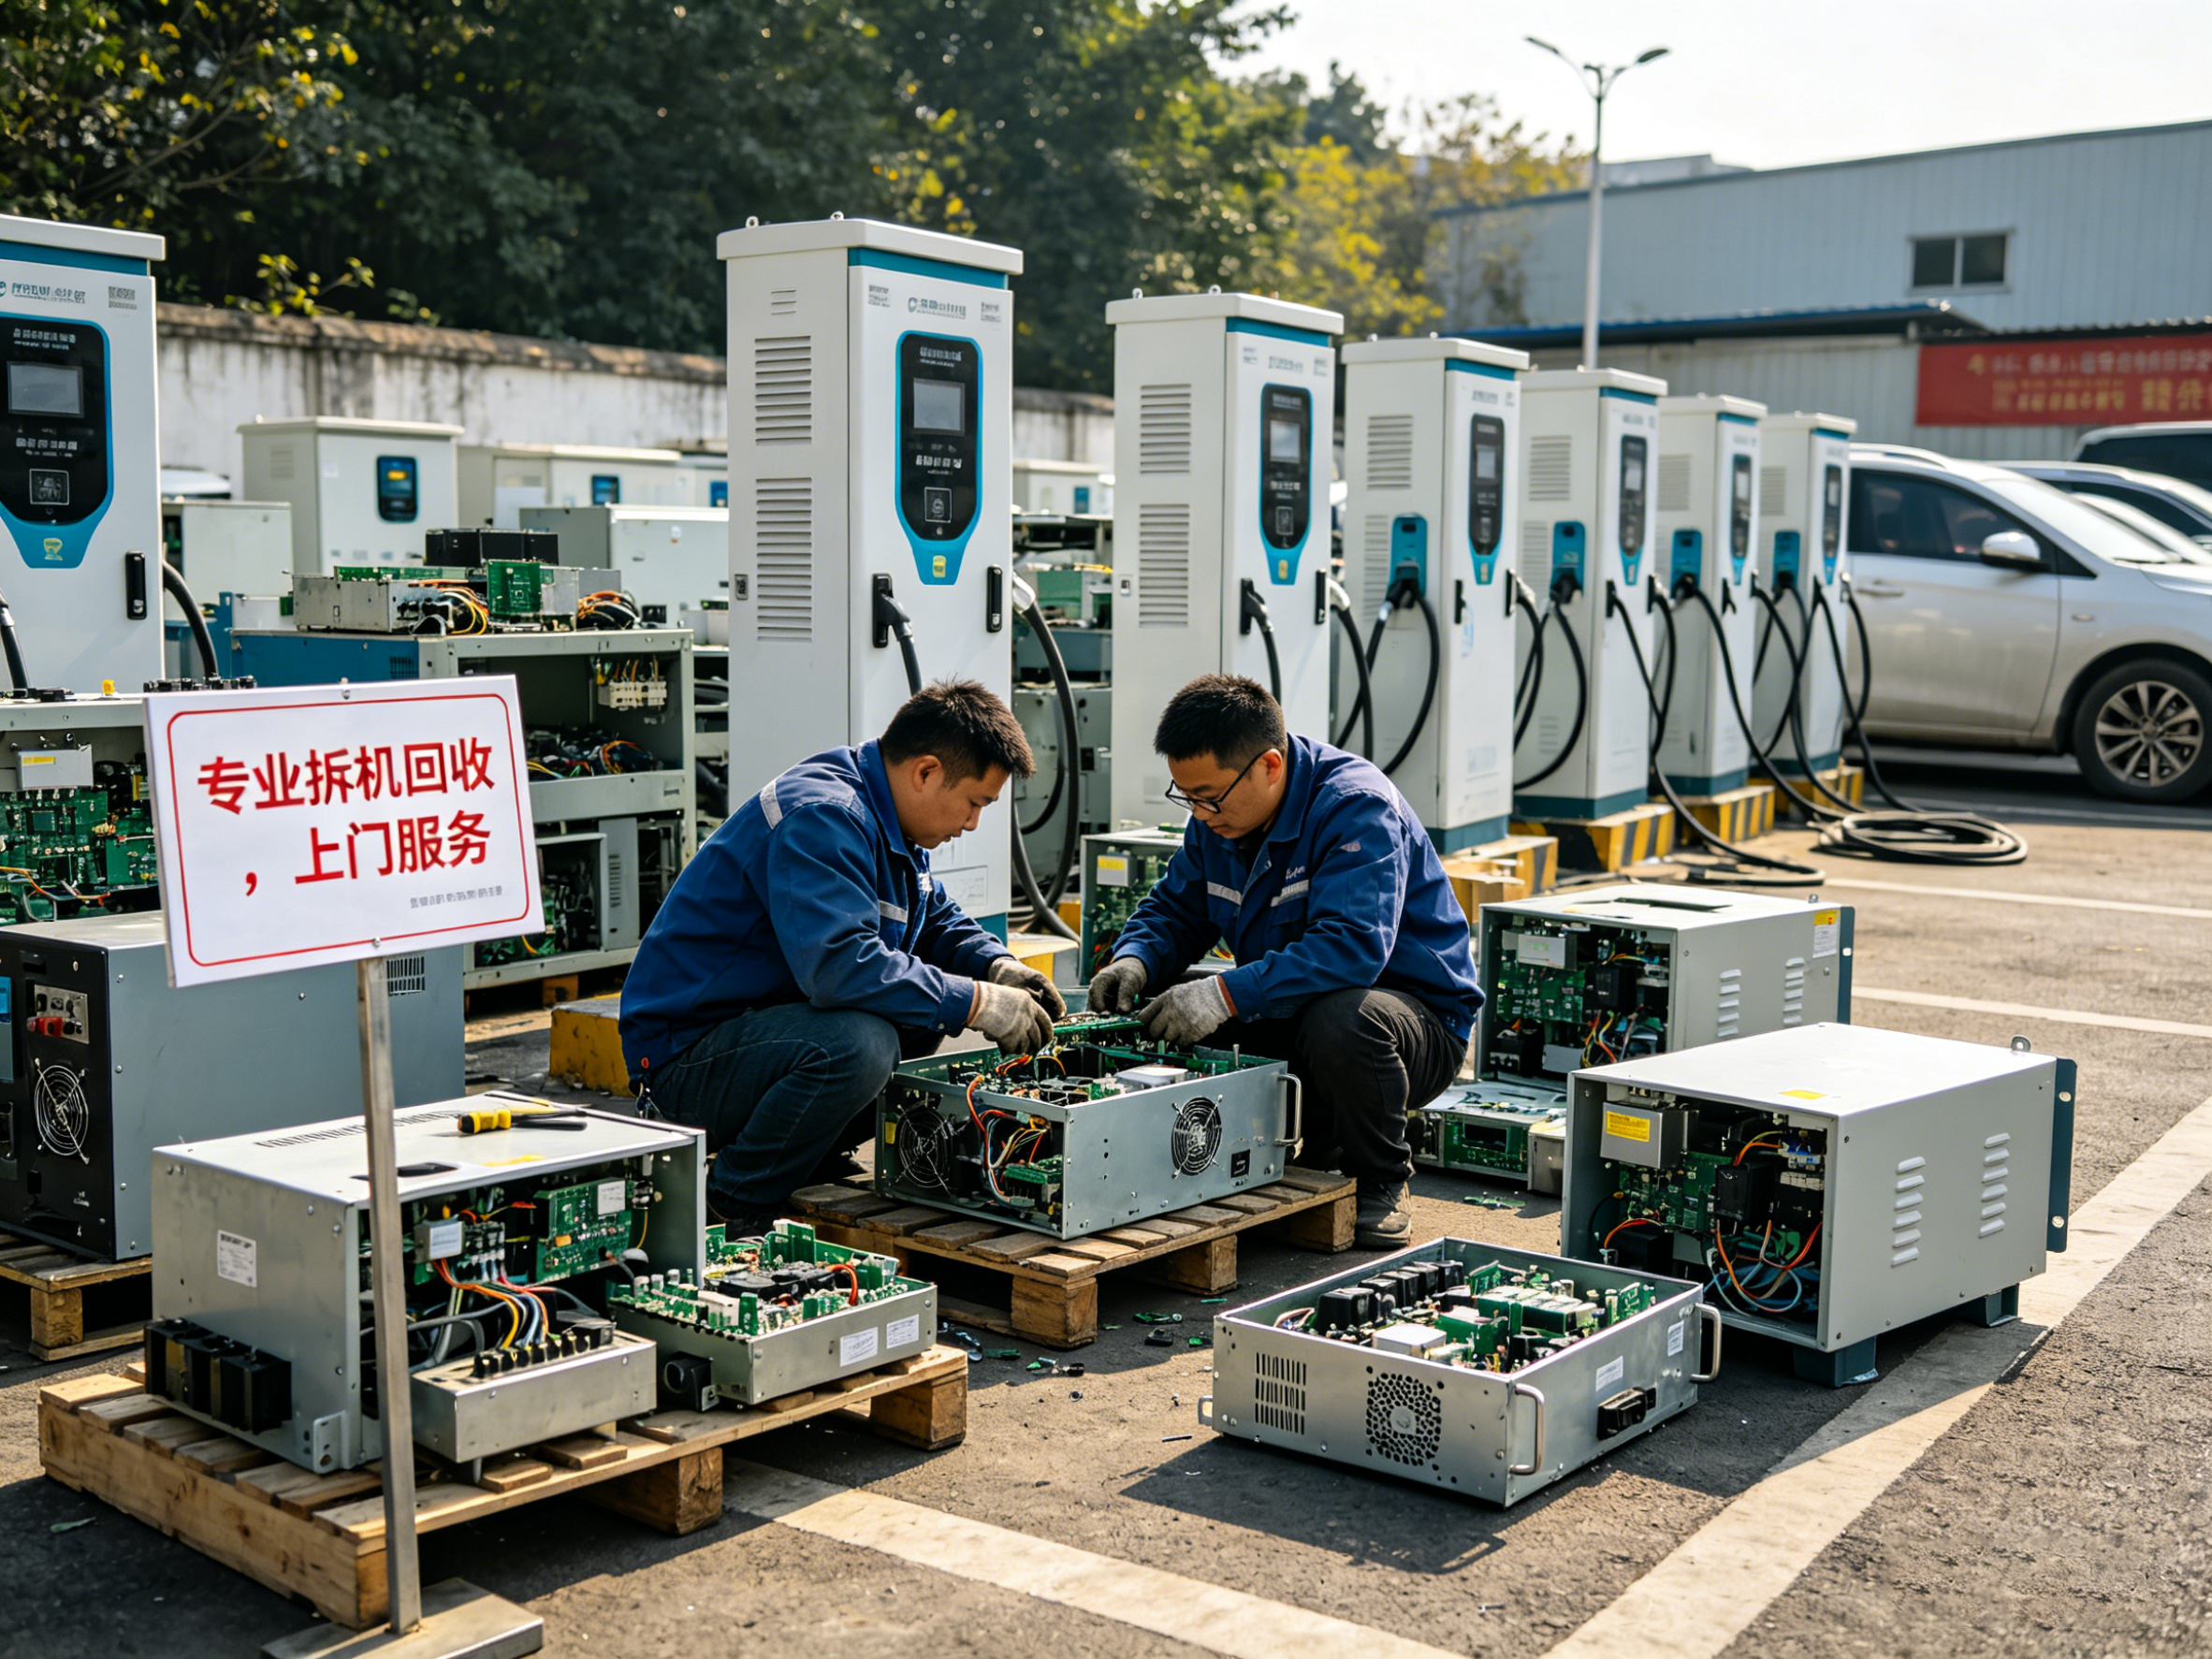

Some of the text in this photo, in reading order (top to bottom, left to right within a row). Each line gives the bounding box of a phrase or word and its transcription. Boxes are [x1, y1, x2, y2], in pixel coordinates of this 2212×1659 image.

[197, 737, 495, 814] 专业拆机回收
